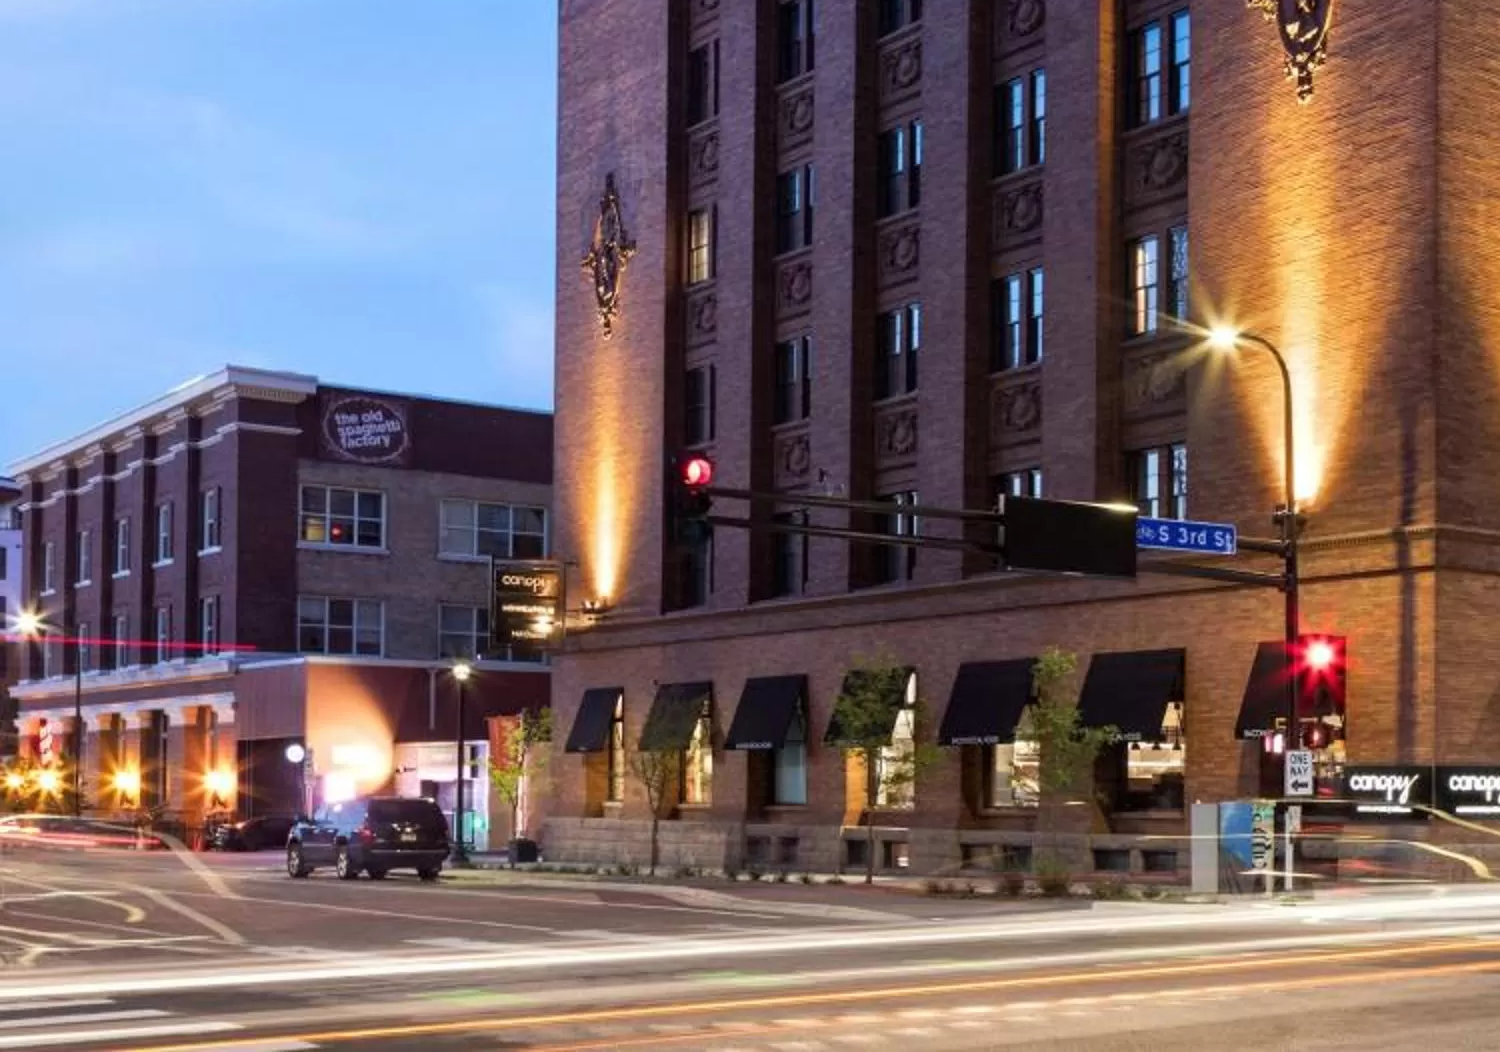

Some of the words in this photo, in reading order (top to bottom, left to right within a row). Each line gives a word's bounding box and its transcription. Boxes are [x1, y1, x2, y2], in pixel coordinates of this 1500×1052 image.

[334, 411, 359, 425] the
[361, 409, 383, 423] old
[337, 419, 401, 439] spaghetti
[341, 434, 391, 449] factory
[1159, 525, 1169, 542] S
[1178, 528, 1208, 545] 3rd
[1214, 531, 1233, 549] St
[1290, 753, 1309, 765] ONE
[1289, 766, 1309, 777] WAY
[1350, 774, 1419, 805] canopy
